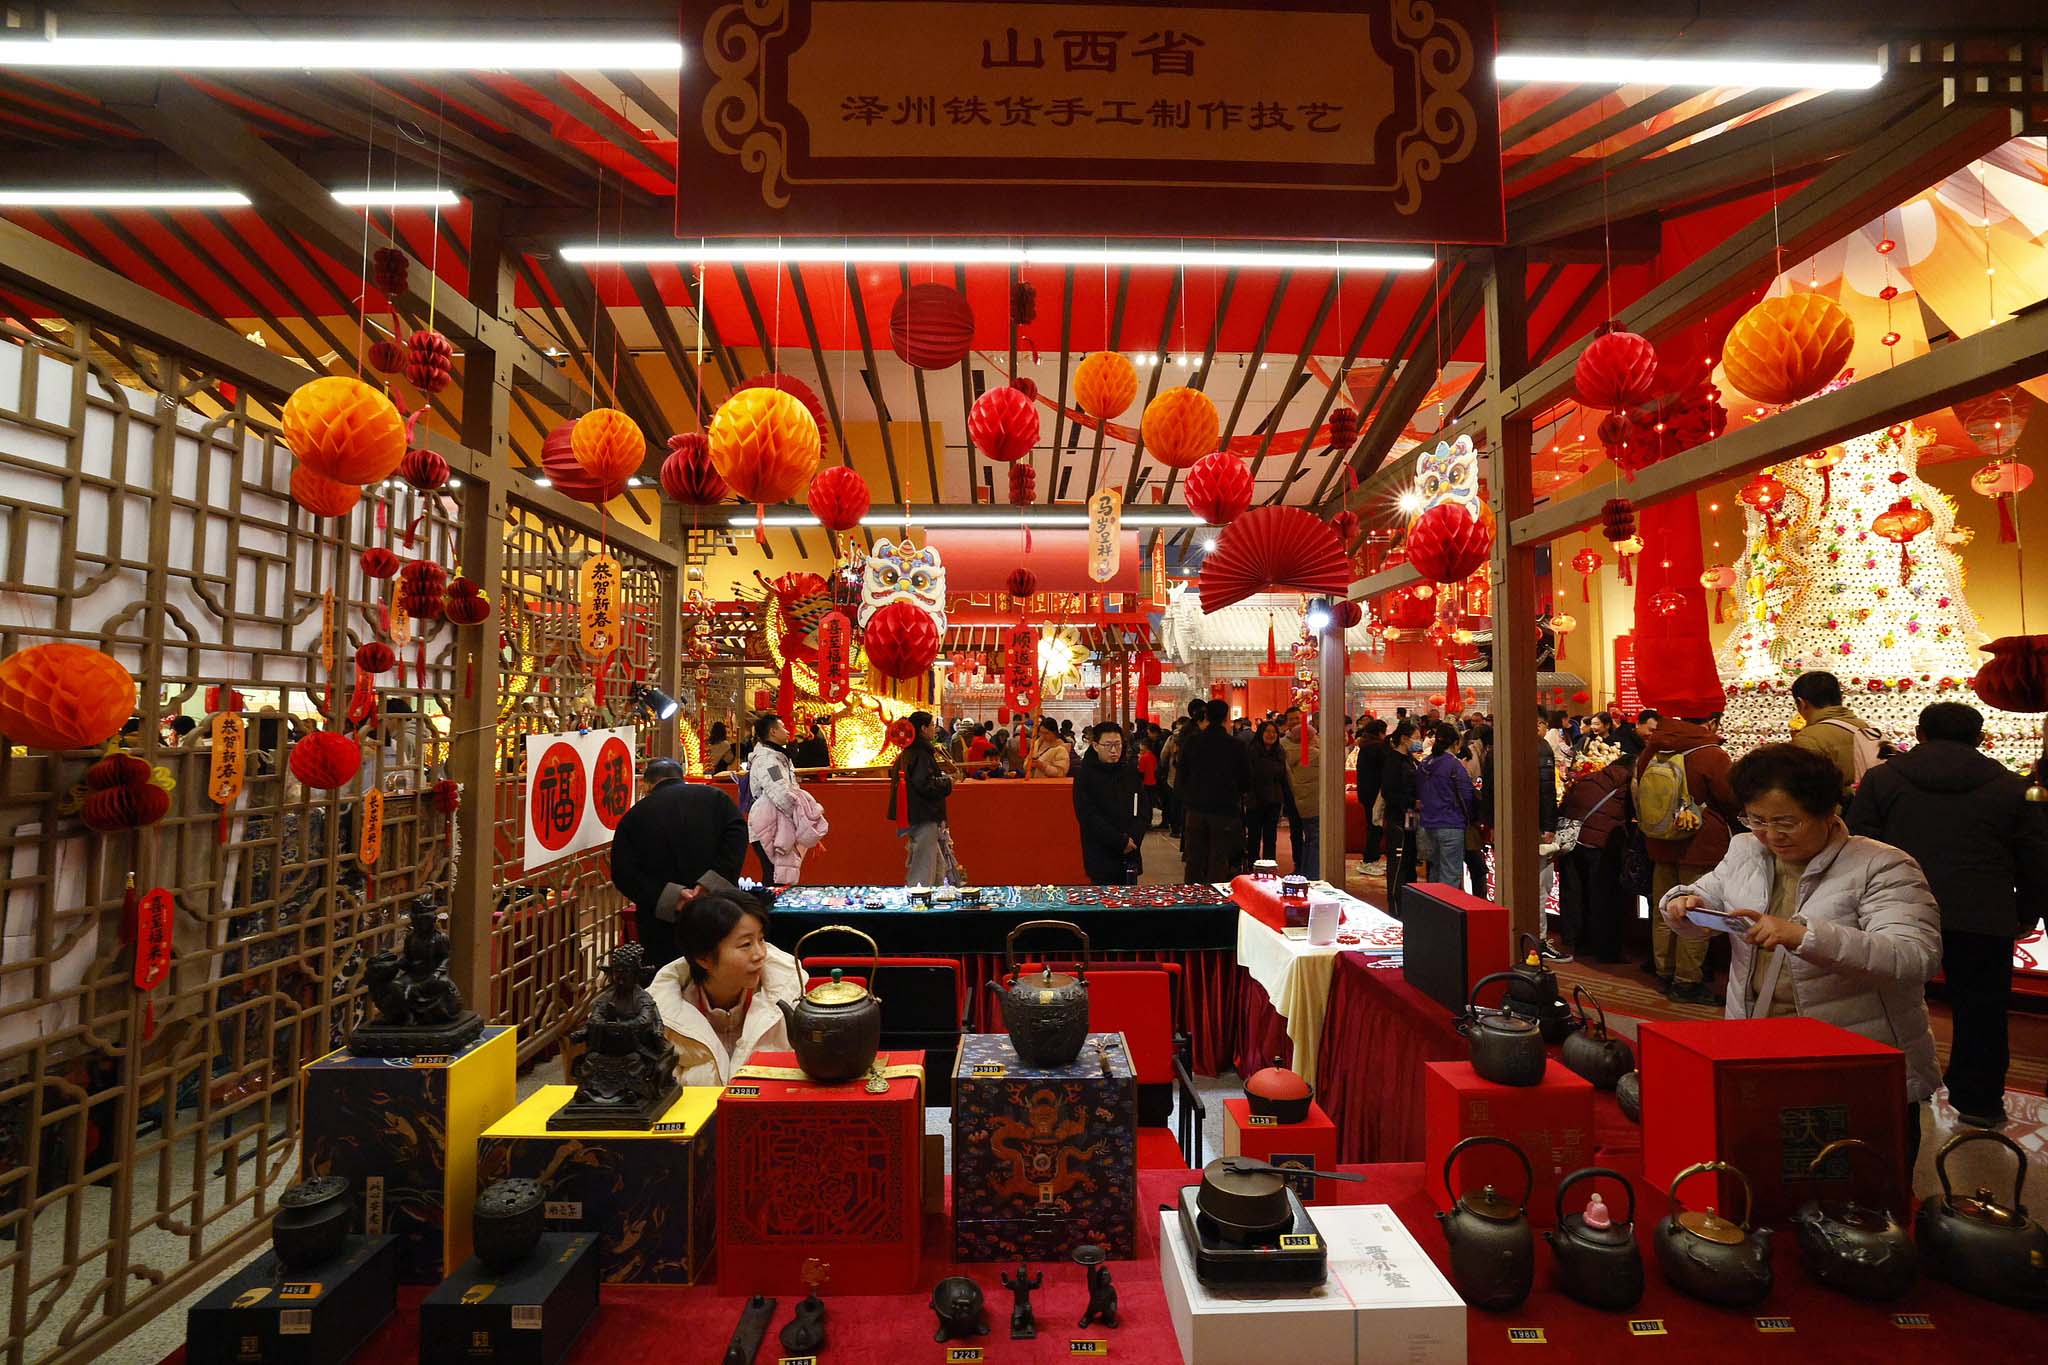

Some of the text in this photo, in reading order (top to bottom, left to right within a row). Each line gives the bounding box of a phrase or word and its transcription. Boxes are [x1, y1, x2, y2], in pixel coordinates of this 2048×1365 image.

[980, 27, 1207, 76] 山西省
[839, 95, 1344, 133] 泽州铁货手工制作技艺
[1096, 496, 1113, 557] 马岁呈祥
[589, 562, 612, 629] 恭贺新春
[827, 619, 841, 678] 喜至福来
[1012, 631, 1032, 688] 顺遂无忧
[217, 719, 238, 780] 恭贺新春
[539, 761, 576, 841] 福
[600, 754, 630, 818] 福
